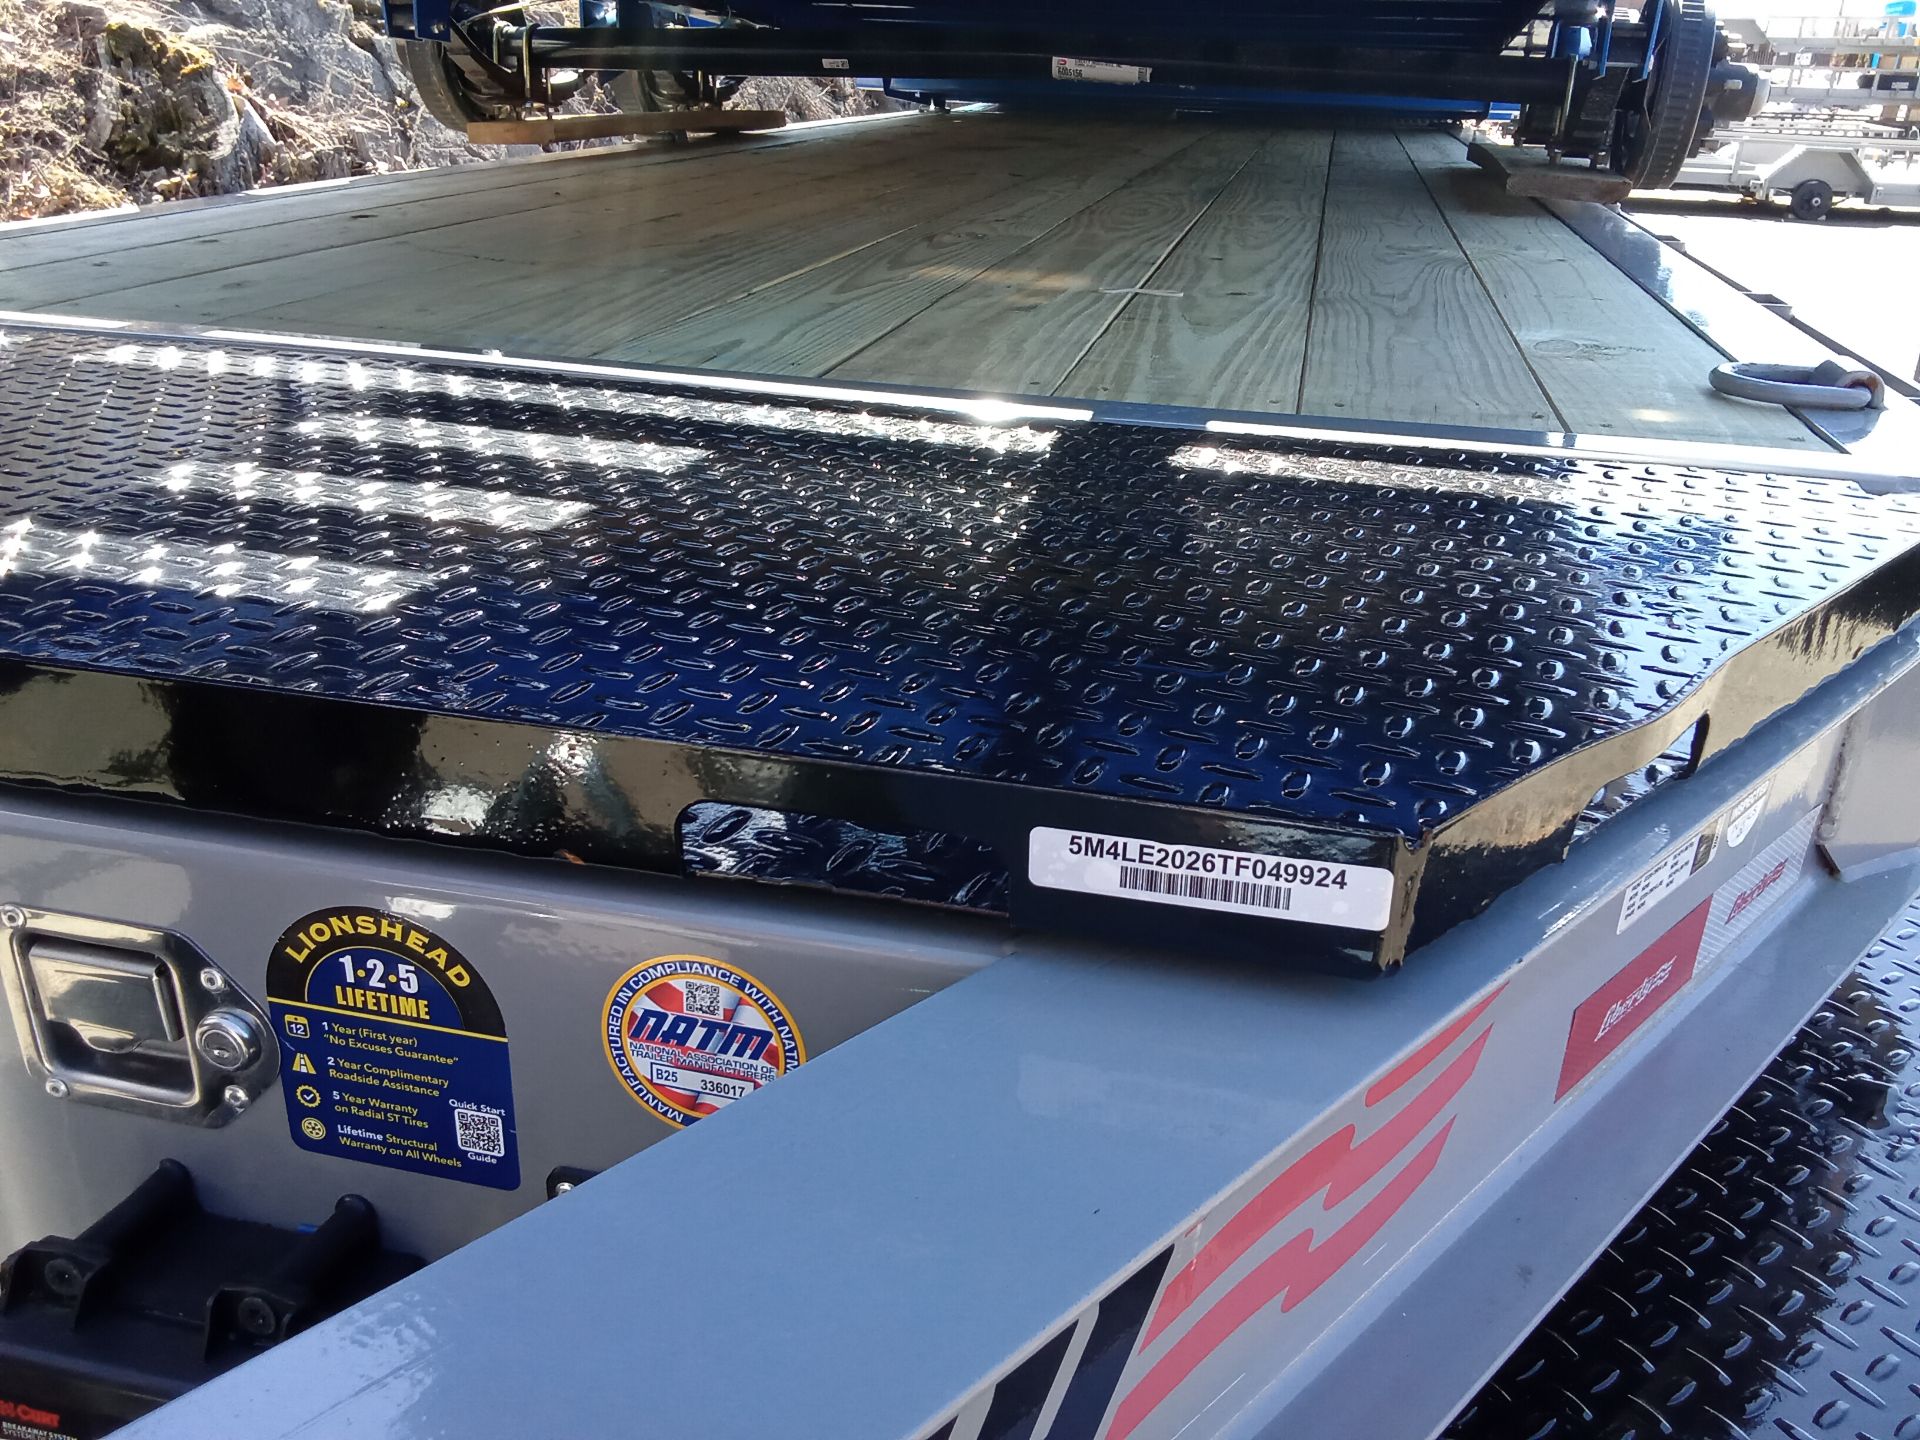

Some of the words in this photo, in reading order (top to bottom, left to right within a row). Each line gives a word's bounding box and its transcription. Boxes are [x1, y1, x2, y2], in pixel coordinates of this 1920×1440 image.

[1068, 835, 1348, 890] 5M4LE2026TF049924
[285, 915, 471, 988] LIONSHEAD
[629, 961, 741, 989] COMPLIANCE
[335, 985, 430, 1020] LIFETIME
[616, 988, 633, 1006] IN
[744, 983, 784, 1022] WITH
[290, 1023, 305, 1035] 12
[322, 1021, 329, 1031] 1
[332, 1023, 356, 1035] Year
[359, 1028, 387, 1041] (First
[389, 1034, 418, 1047] year)
[348, 1038, 393, 1054] Excuses
[629, 1041, 683, 1058] NATIONAL
[686, 1052, 759, 1072] ASSOCIATION
[761, 1066, 776, 1075] OF
[777, 1025, 800, 1075] NATM
[327, 1056, 336, 1066] 2
[337, 1058, 361, 1070] Year
[363, 1063, 449, 1088] Complimentary
[608, 1005, 684, 1123] MANUFACTURED
[630, 1049, 675, 1063] TRAILER
[677, 1058, 776, 1082] MANUFACTURERS
[329, 1068, 380, 1086] Roadside
[382, 1079, 440, 1097] Assistance
[656, 1068, 678, 1083] B25
[700, 1079, 746, 1098] 336017
[332, 1090, 340, 1100] 5
[342, 1092, 366, 1104] Year
[368, 1097, 418, 1116] Warranty
[334, 1105, 349, 1113] on
[350, 1105, 385, 1120] Radial
[386, 1113, 400, 1123] ST
[402, 1115, 429, 1128] Tires
[448, 1099, 478, 1110] Quick
[480, 1104, 506, 1116] Start
[337, 1124, 384, 1141] Lifetime
[385, 1133, 438, 1151] Structural
[339, 1136, 387, 1155] Warranty
[389, 1148, 404, 1156] on
[405, 1150, 420, 1159] All
[421, 1152, 462, 1168] Wheels
[467, 1152, 498, 1164] Guide
[2, 1421, 48, 1437] BREAKAWAY
